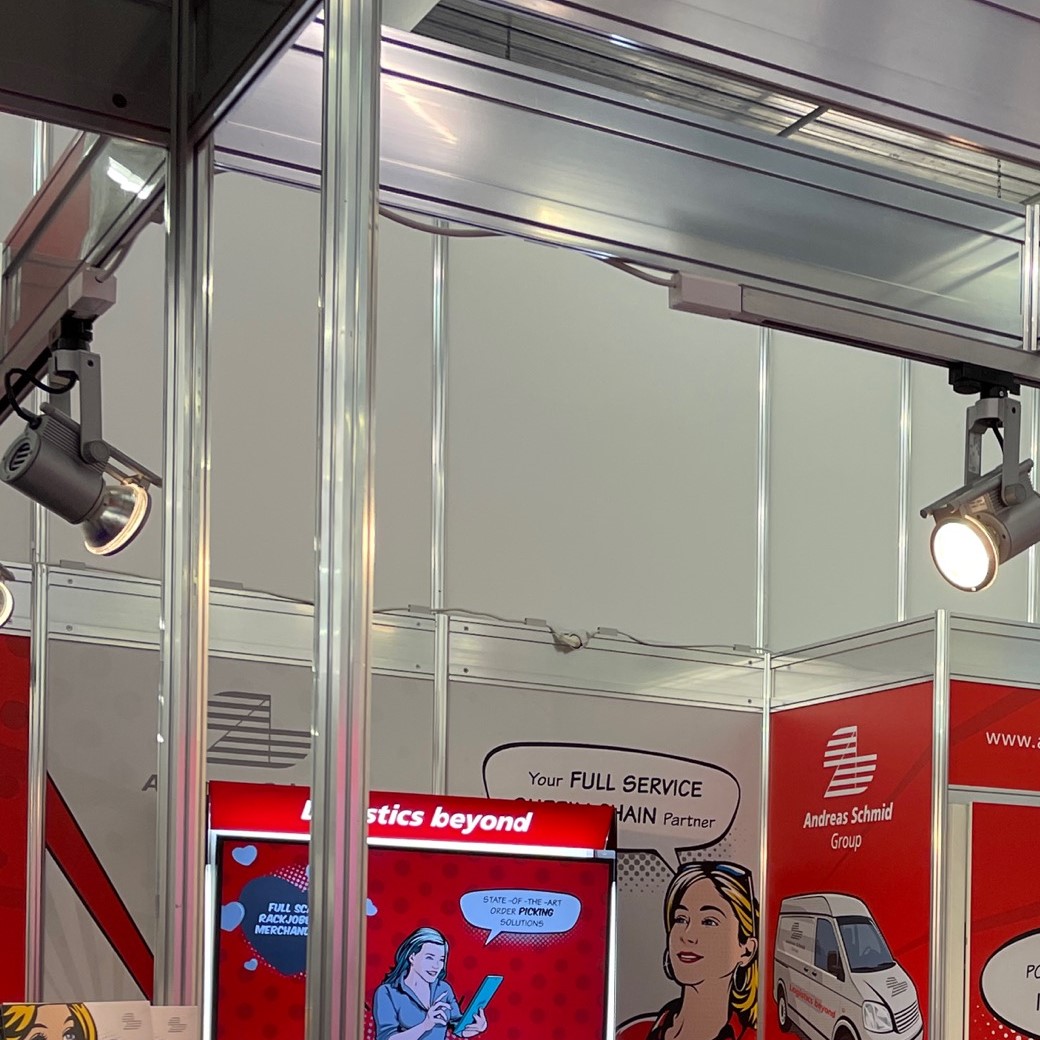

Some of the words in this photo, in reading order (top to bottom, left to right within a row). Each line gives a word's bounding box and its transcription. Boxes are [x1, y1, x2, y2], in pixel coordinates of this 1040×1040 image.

[528, 771, 563, 788] Your
[570, 771, 615, 791] FULL
[623, 775, 702, 797] SERVICE
[431, 811, 533, 835] beyond
[611, 803, 657, 825] HAIN
[664, 812, 715, 828] Partner
[803, 810, 848, 828] Andreas
[851, 802, 893, 824] Schmid
[831, 833, 862, 852] Group
[268, 903, 291, 913] FULL
[483, 896, 507, 904] STATE
[490, 907, 516, 915] ORDER
[519, 907, 554, 917] PICKING
[500, 918, 544, 928] SOLUTIONS
